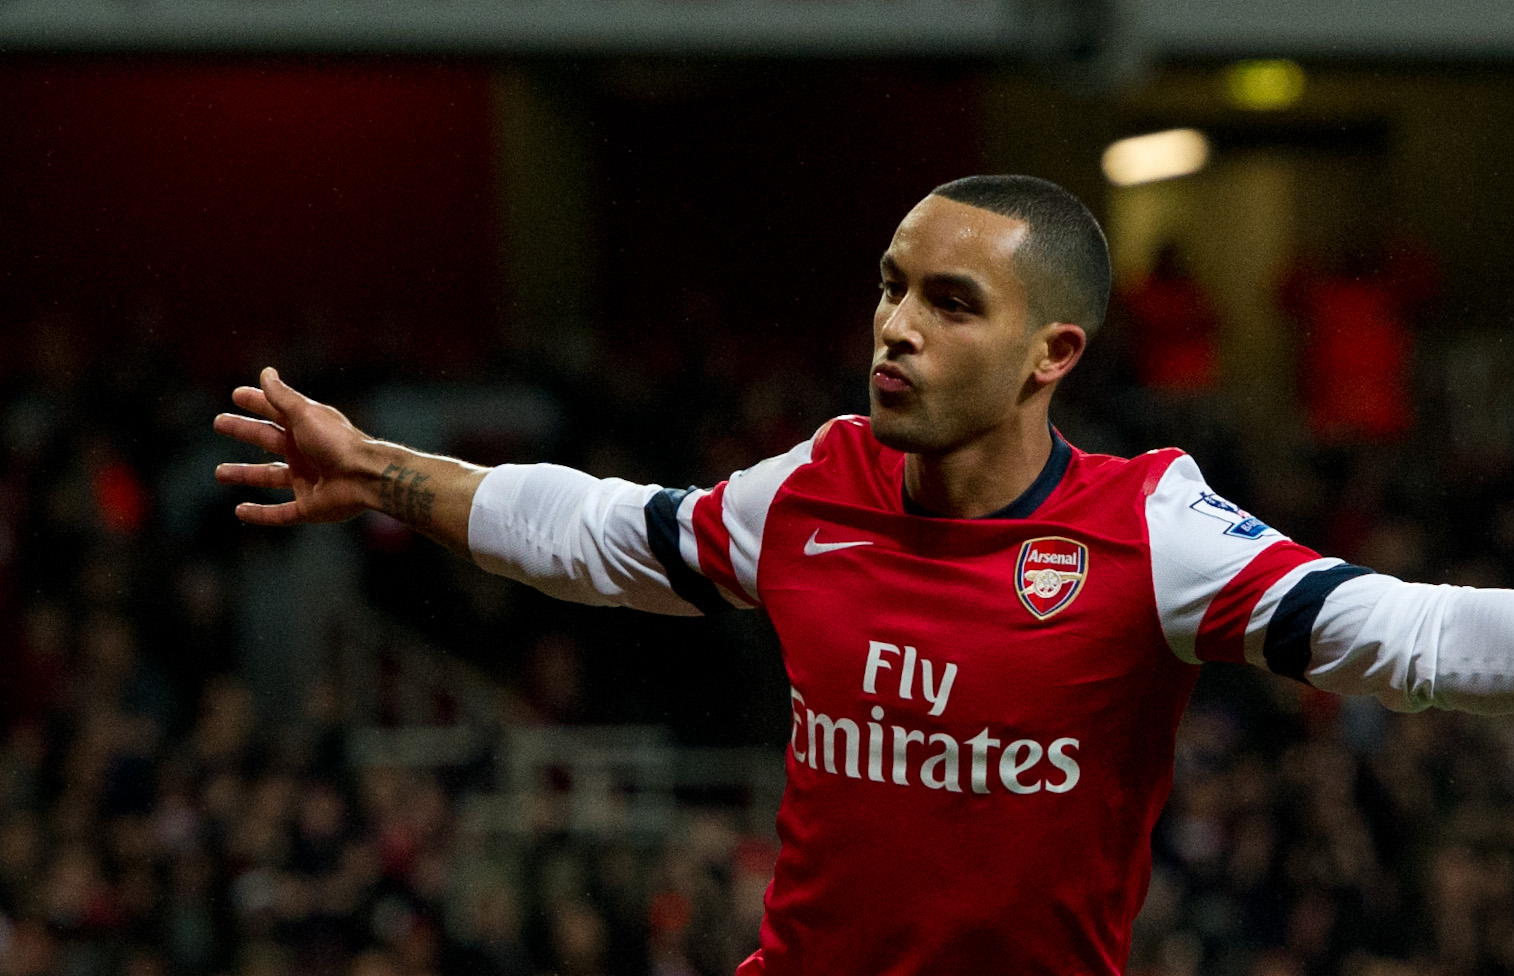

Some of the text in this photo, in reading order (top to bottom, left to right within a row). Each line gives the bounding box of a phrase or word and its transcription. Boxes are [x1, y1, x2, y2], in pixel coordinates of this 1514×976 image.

[1028, 549, 1077, 565] Arsenal
[863, 640, 958, 716] Fly
[791, 686, 1081, 794] Emirates
